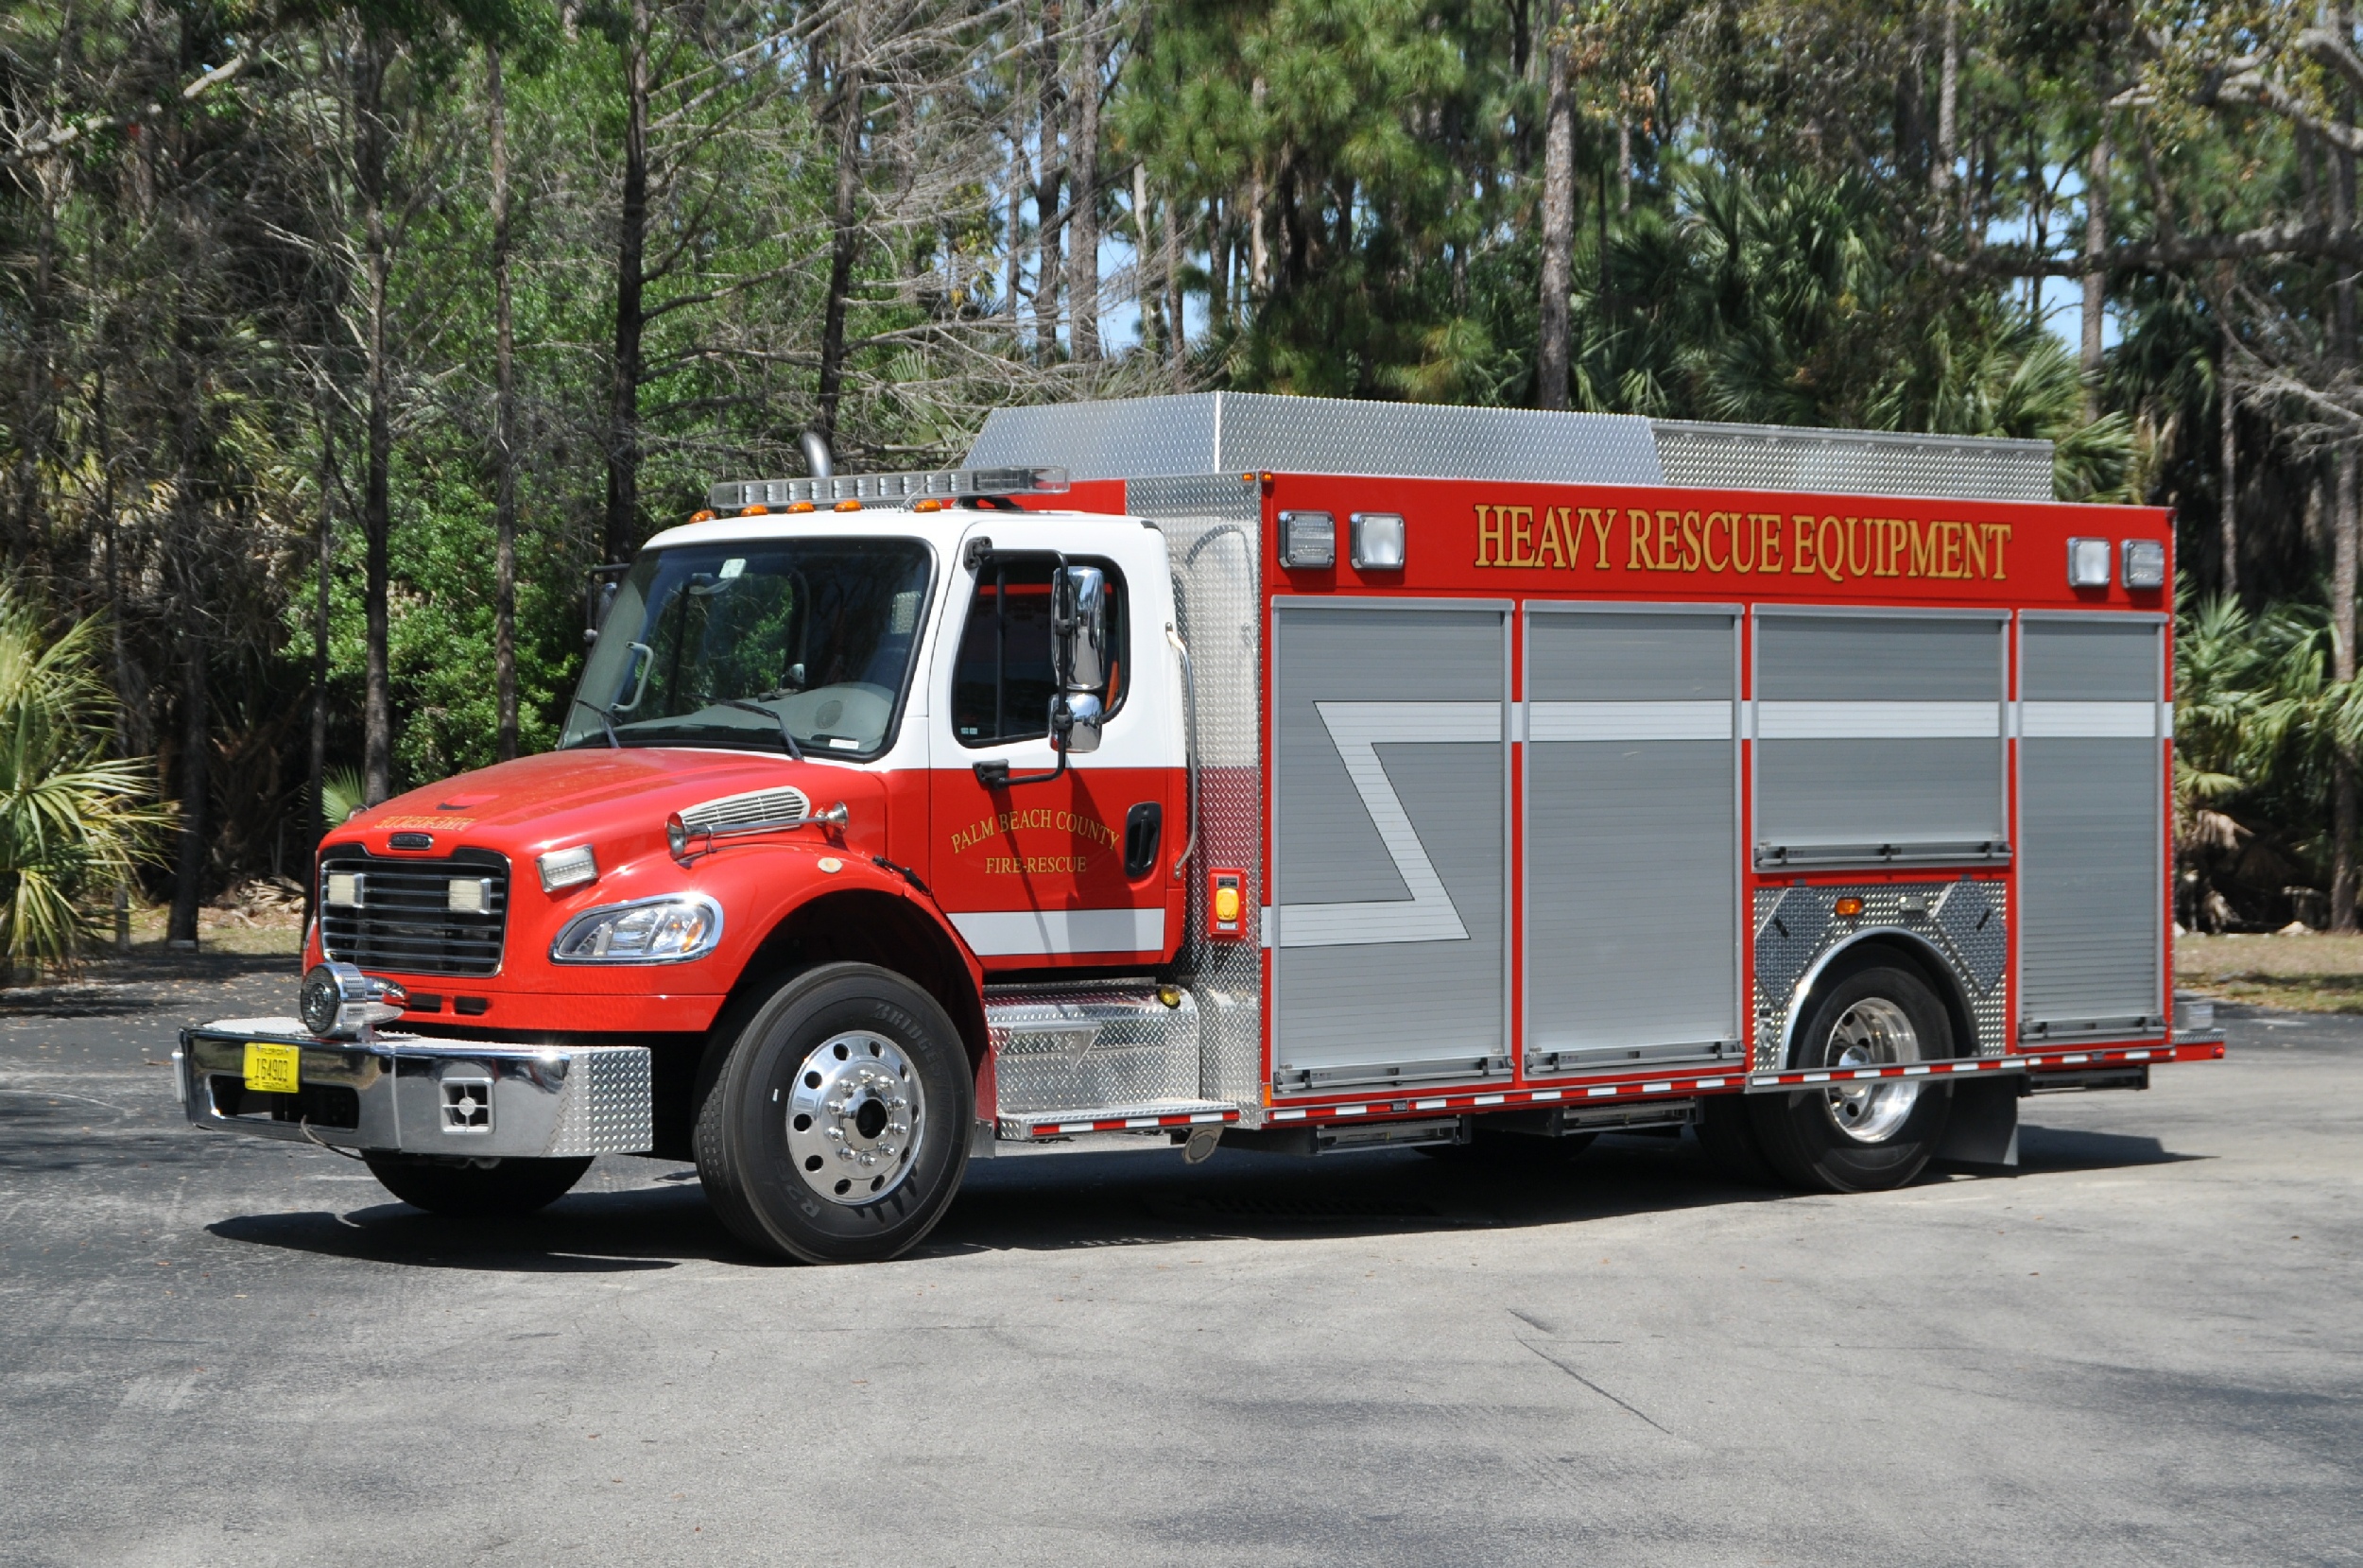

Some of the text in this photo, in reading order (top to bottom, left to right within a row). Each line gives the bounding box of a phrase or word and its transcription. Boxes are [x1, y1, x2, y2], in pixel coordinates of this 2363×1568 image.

[1473, 503, 2012, 583] HEAVY RESCUE EQUIPMENT
[950, 809, 1120, 854] PALM BEACH COUNTY
[984, 856, 1087, 874] FIRE-RESCUE
